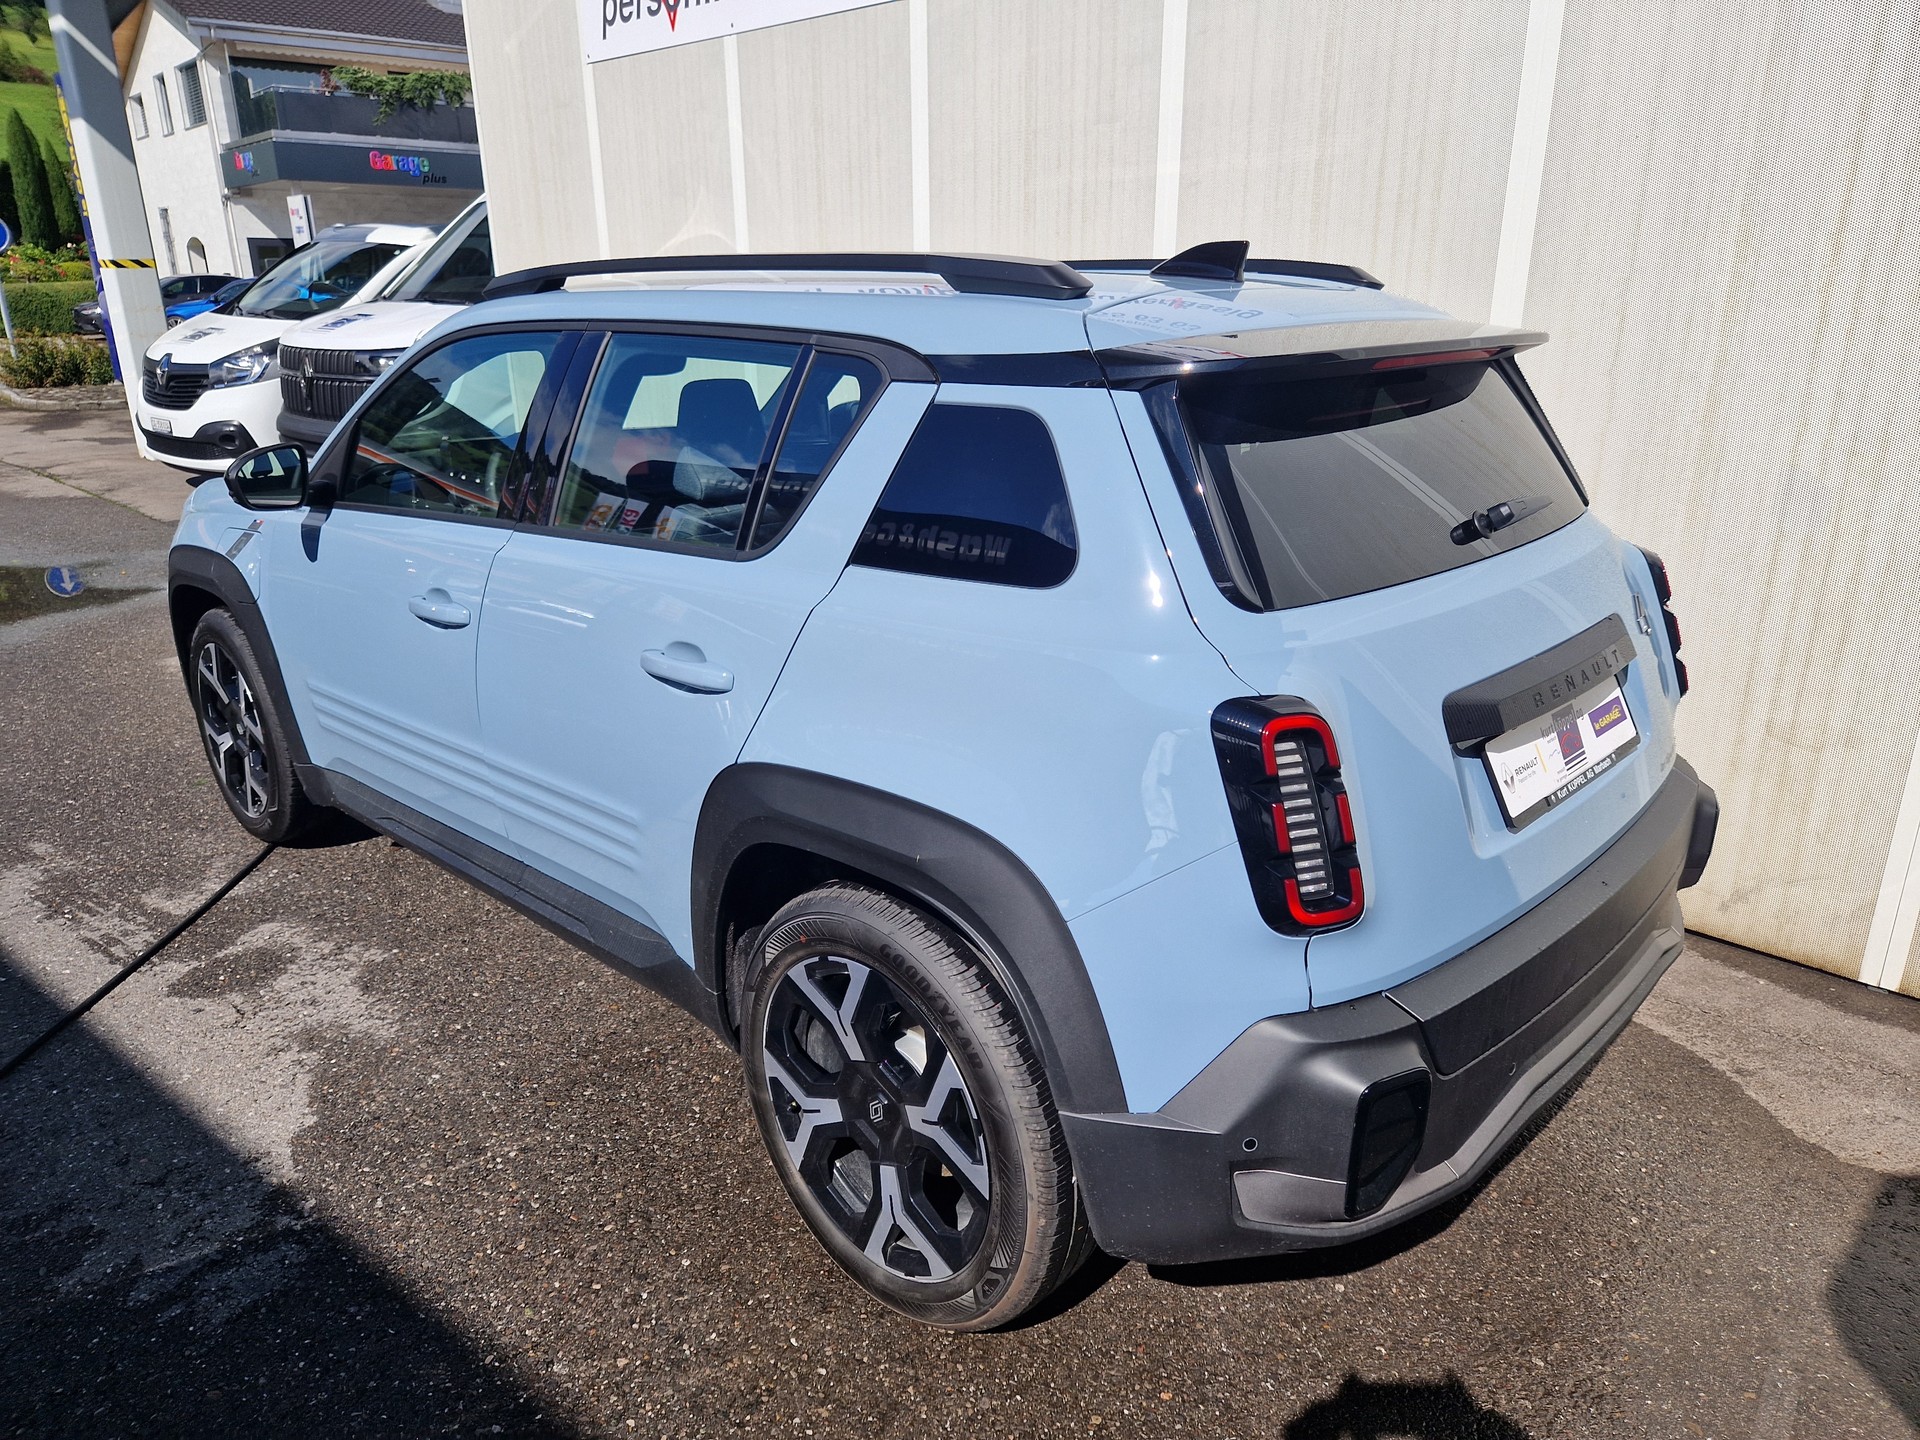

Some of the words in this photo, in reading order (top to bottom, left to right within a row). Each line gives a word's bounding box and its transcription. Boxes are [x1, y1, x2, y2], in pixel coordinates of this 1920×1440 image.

[369, 150, 430, 177] Garage
[422, 173, 448, 185] plus
[1532, 649, 1620, 709] RENAULT
[1514, 756, 1539, 777] RENAULT
[1556, 786, 1570, 800] Kurt
[1585, 768, 1595, 780] AG
[880, 943, 983, 1070] GOODYEAR
